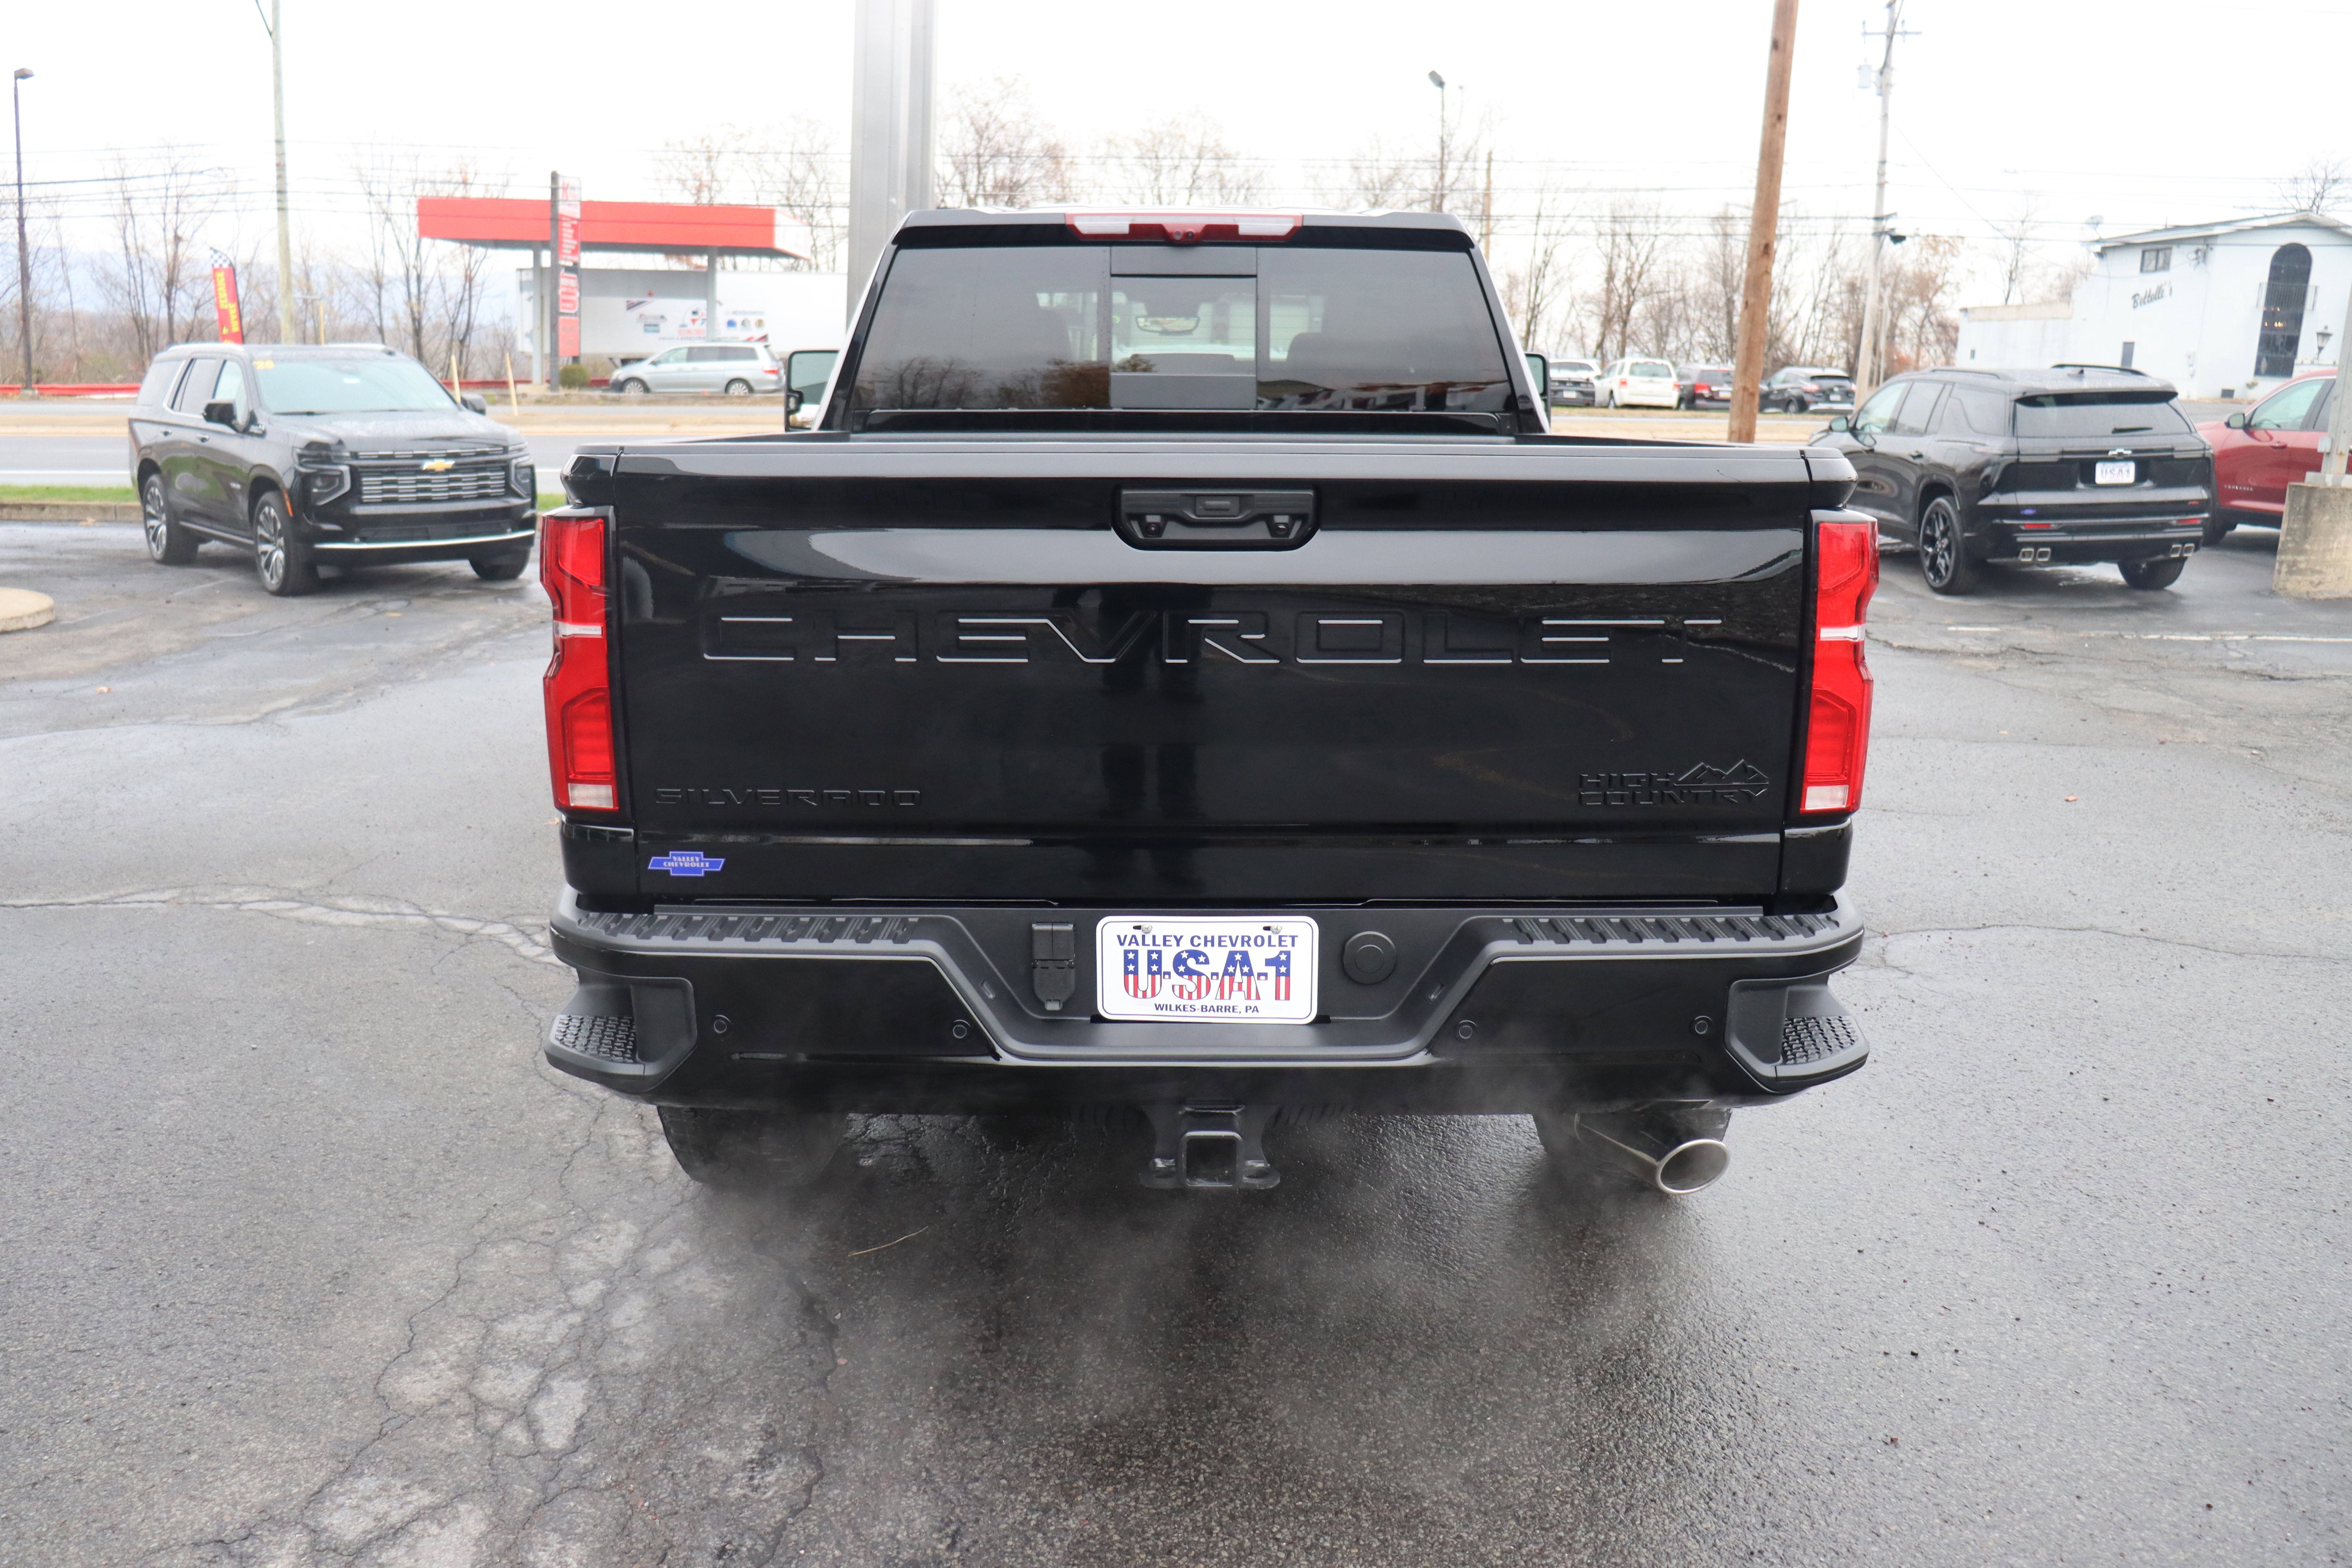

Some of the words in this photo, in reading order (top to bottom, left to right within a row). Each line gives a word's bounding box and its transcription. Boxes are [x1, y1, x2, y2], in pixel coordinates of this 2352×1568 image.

[701, 609, 1725, 664] CHEVROLET
[1579, 773, 1675, 788] HIGH
[655, 788, 922, 806] SILVERADO
[1579, 788, 1768, 805] COUNTRY
[1116, 934, 1184, 947] VALLEY
[1190, 935, 1298, 947] CHEVROLET
[1154, 1003, 1242, 1015] WILKES-BARRE,
[1245, 1005, 1259, 1013] PA
